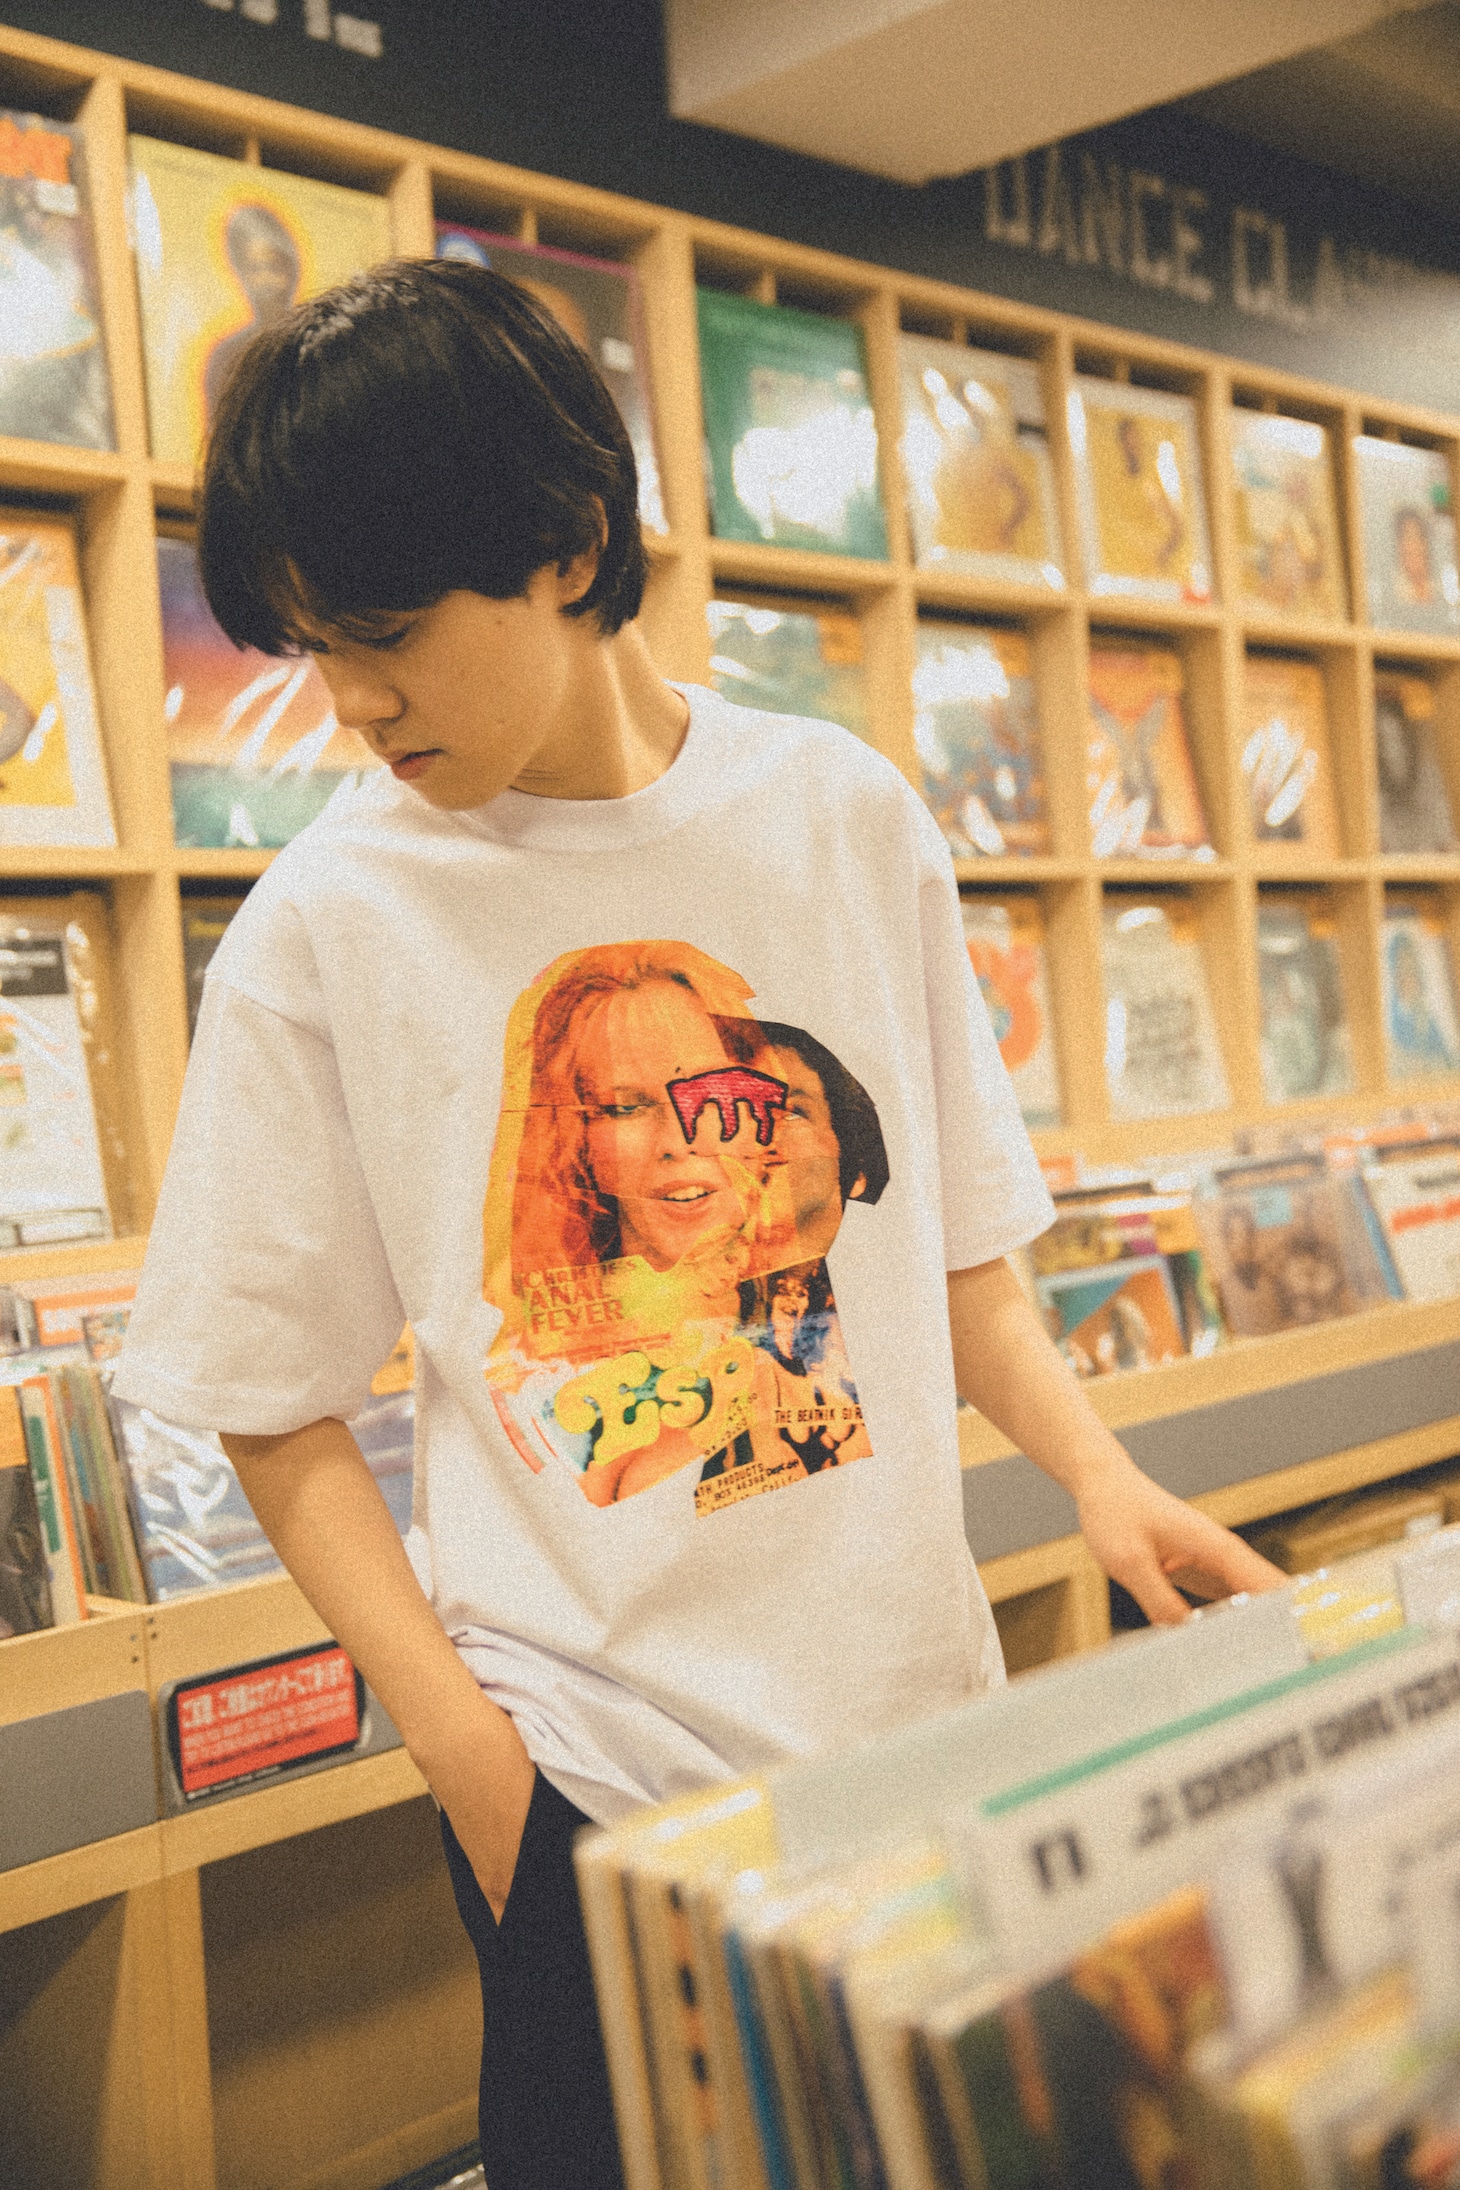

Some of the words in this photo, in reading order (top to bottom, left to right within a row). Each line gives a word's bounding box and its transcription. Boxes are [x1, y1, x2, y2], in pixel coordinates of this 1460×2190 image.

[530, 1279, 612, 1312] ANAL
[530, 1299, 624, 1335] FEVER
[774, 1409, 793, 1424] THE
[717, 1463, 765, 1488] PRODUCTS
